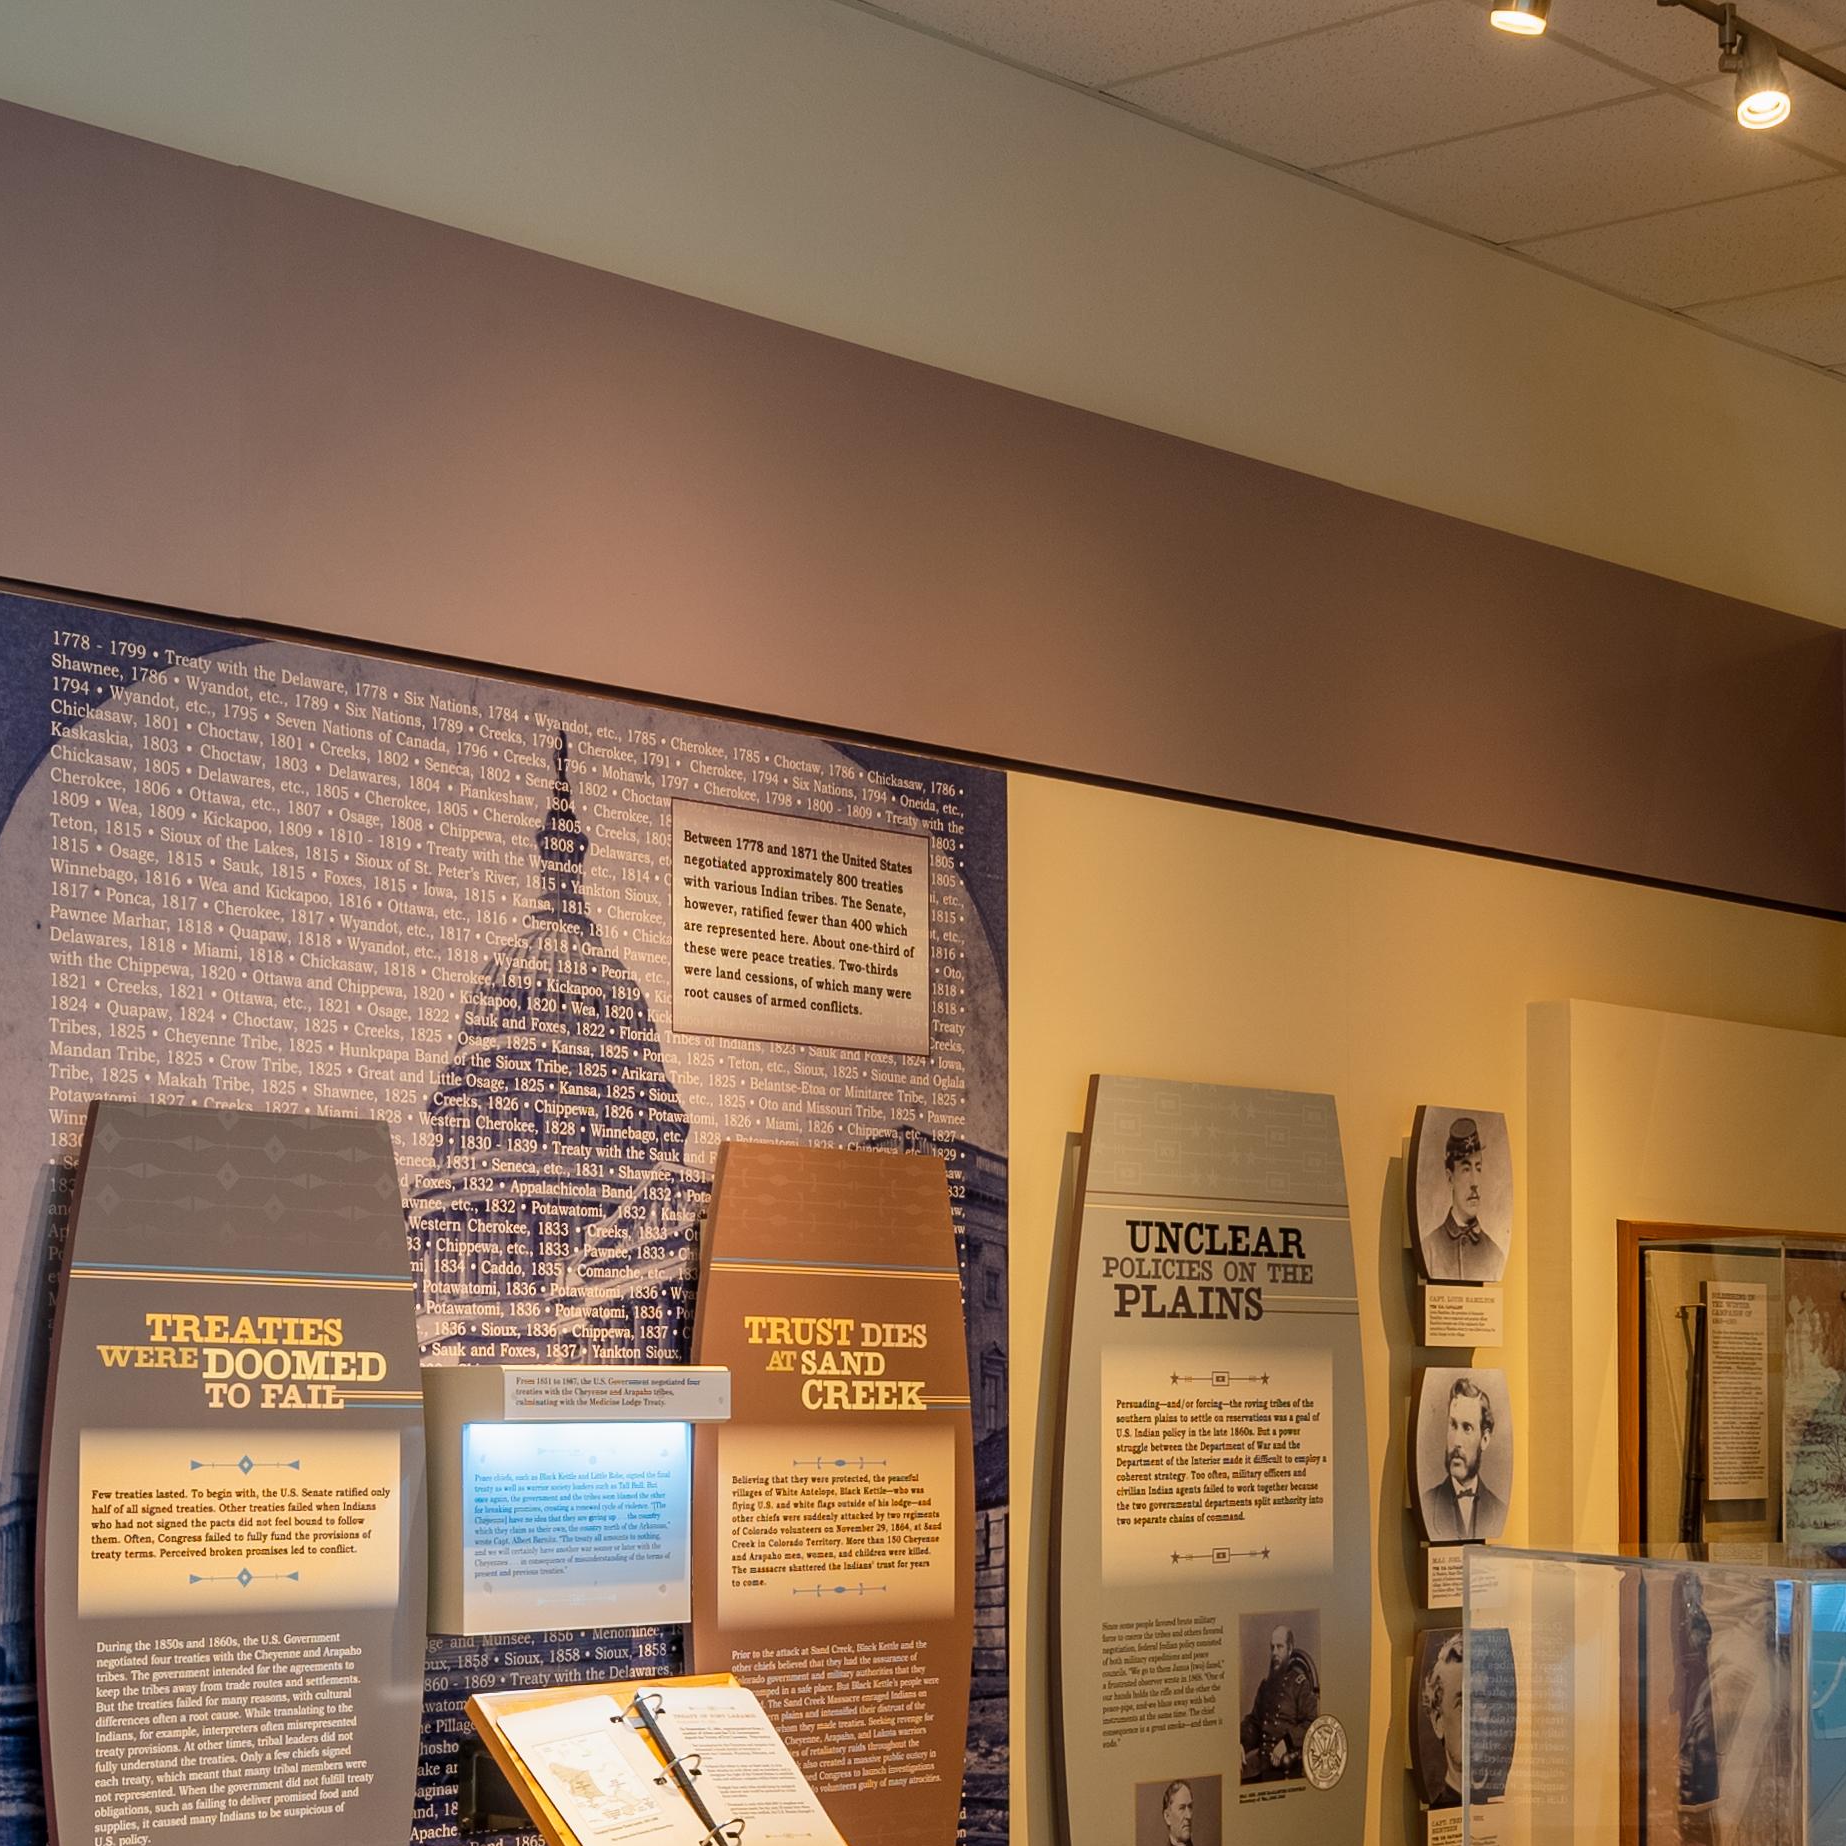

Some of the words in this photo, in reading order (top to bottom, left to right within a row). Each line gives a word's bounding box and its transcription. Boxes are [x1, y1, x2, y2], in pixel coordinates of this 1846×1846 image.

[53, 629, 91, 651] 1778
[110, 639, 147, 660] 1799
[163, 648, 213, 675] Treaty
[215, 659, 249, 678] with
[253, 663, 277, 683] the
[280, 667, 349, 697] Delaware,
[355, 681, 388, 701] 1778
[403, 689, 425, 708] Six
[428, 693, 483, 720] Nations,
[487, 704, 519, 724] 1784
[533, 711, 593, 739] Wyandot,
[595, 726, 622, 743] etc.,
[627, 728, 657, 747] 1785
[669, 735, 728, 761] Cherokee,
[733, 746, 761, 764] 1785
[773, 753, 825, 777] Choctaw,
[828, 762, 856, 780] 1786
[866, 769, 926, 795] Chickasaw,
[930, 780, 956, 798] 1786
[683, 828, 733, 849] Between
[735, 836, 765, 854] 1778
[766, 842, 788, 857] and
[790, 844, 818, 862] 1871
[820, 849, 840, 865] the
[841, 851, 878, 871] United
[878, 857, 913, 875] States
[1126, 1220, 1306, 1259] UNCLEAR
[1102, 1256, 1213, 1281] POLICIES
[1224, 1261, 1256, 1282] ON
[1267, 1263, 1313, 1284] THE
[1114, 1284, 1263, 1321] PLAINS
[145, 1313, 343, 1347] TREATIES
[744, 1316, 854, 1346] TRUST
[860, 1323, 928, 1348] DIES
[96, 1345, 199, 1369] WERE
[202, 1348, 387, 1382] DOOMED
[766, 1350, 797, 1371] AT
[801, 1349, 886, 1376] SAND
[205, 1383, 251, 1409] TO
[260, 1384, 345, 1410] FAIL
[801, 1379, 927, 1411] CREEK
[1133, 1427, 1161, 1438] Indian
[1161, 1427, 1187, 1441] policy
[1187, 1427, 1197, 1438] in
[1197, 1426, 1212, 1437] the
[1212, 1426, 1228, 1437] late
[1256, 1425, 1271, 1437] But
[1271, 1428, 1278, 1437] a
[1277, 1427, 1301, 1439] power
[91, 1488, 113, 1500] Few
[114, 1488, 154, 1500] treaties
[155, 1487, 188, 1499] lasted.
[190, 1487, 204, 1499] To
[205, 1487, 233, 1501] begin
[234, 1487, 259, 1500] with,
[261, 1487, 278, 1498] the
[279, 1487, 297, 1499] U.S.
[300, 1487, 333, 1498] Senate
[334, 1486, 369, 1498] ratified
[370, 1486, 391, 1499] only
[731, 1474, 770, 1487] Believing
[770, 1474, 789, 1485] that
[789, 1474, 809, 1486] they
[810, 1475, 829, 1484] were
[830, 1473, 871, 1486] protected,
[872, 1473, 886, 1483] the
[886, 1472, 920, 1485] peaceful
[95, 1640, 133, 1655] During
[133, 1639, 152, 1652] the
[154, 1637, 185, 1651] 1850s
[185, 1636, 206, 1649] and
[208, 1635, 241, 1648] 1860s,
[242, 1634, 260, 1647] the
[260, 1633, 282, 1646] U.S.
[282, 1632, 341, 1645] Government
